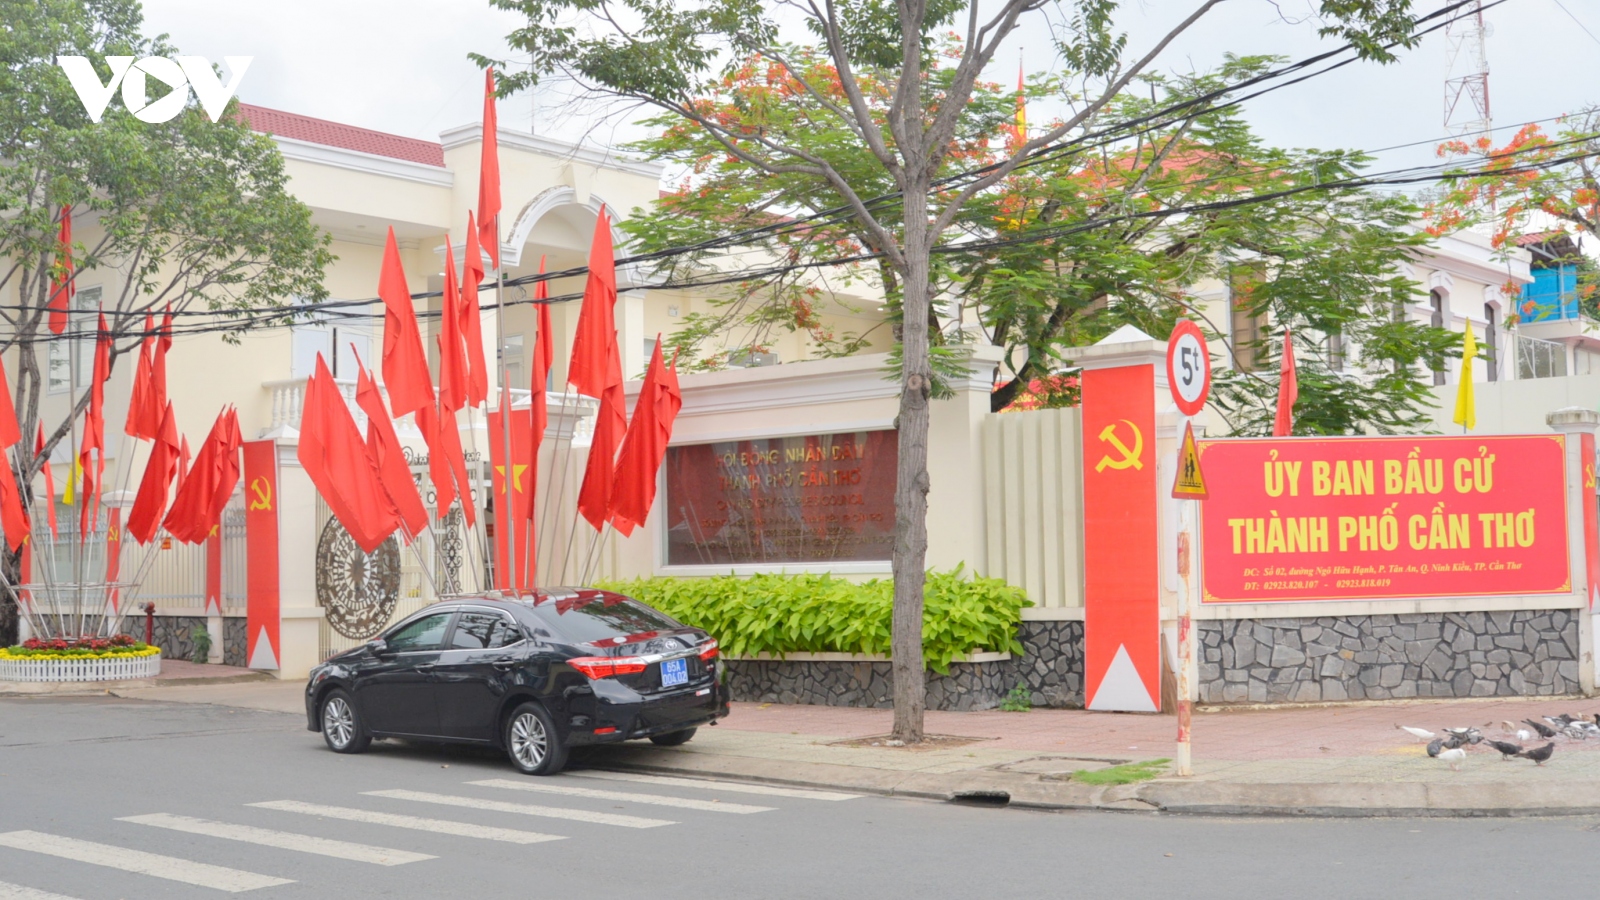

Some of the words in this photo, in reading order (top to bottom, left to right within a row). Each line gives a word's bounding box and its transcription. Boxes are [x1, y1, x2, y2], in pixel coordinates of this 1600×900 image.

[785, 443, 826, 463] NHÂN
[832, 441, 864, 461] DÂN
[797, 464, 829, 486] CẦN
[1264, 449, 1302, 497] ỦY
[1312, 460, 1375, 496] BAN
[1384, 446, 1444, 494] BẦU
[1453, 445, 1496, 493] CỬ
[1228, 509, 1329, 554] THÀNH
[1338, 502, 1399, 552] PHỐ
[1408, 501, 1471, 550] CẦN
[1478, 508, 1535, 548] THƠ
[1263, 565, 1275, 576] Số
[1275, 567, 1287, 577] 02,
[1315, 566, 1332, 577] Ngô
[1333, 565, 1351, 575] Hữu
[1352, 564, 1377, 576] Hạnh,
[1378, 564, 1387, 574] P.
[1388, 564, 1404, 573] Tân
[1405, 564, 1418, 574] An,
[1420, 563, 1429, 574] Q.
[1431, 562, 1451, 572] Ninh
[1452, 560, 1472, 572] Kiều,
[1474, 562, 1487, 571] TP.
[1488, 559, 1505, 571] Cần
[1506, 561, 1523, 570] Thơ
[1263, 580, 1319, 590] 02923.820.107
[1336, 578, 1391, 588] 02923.818.019
